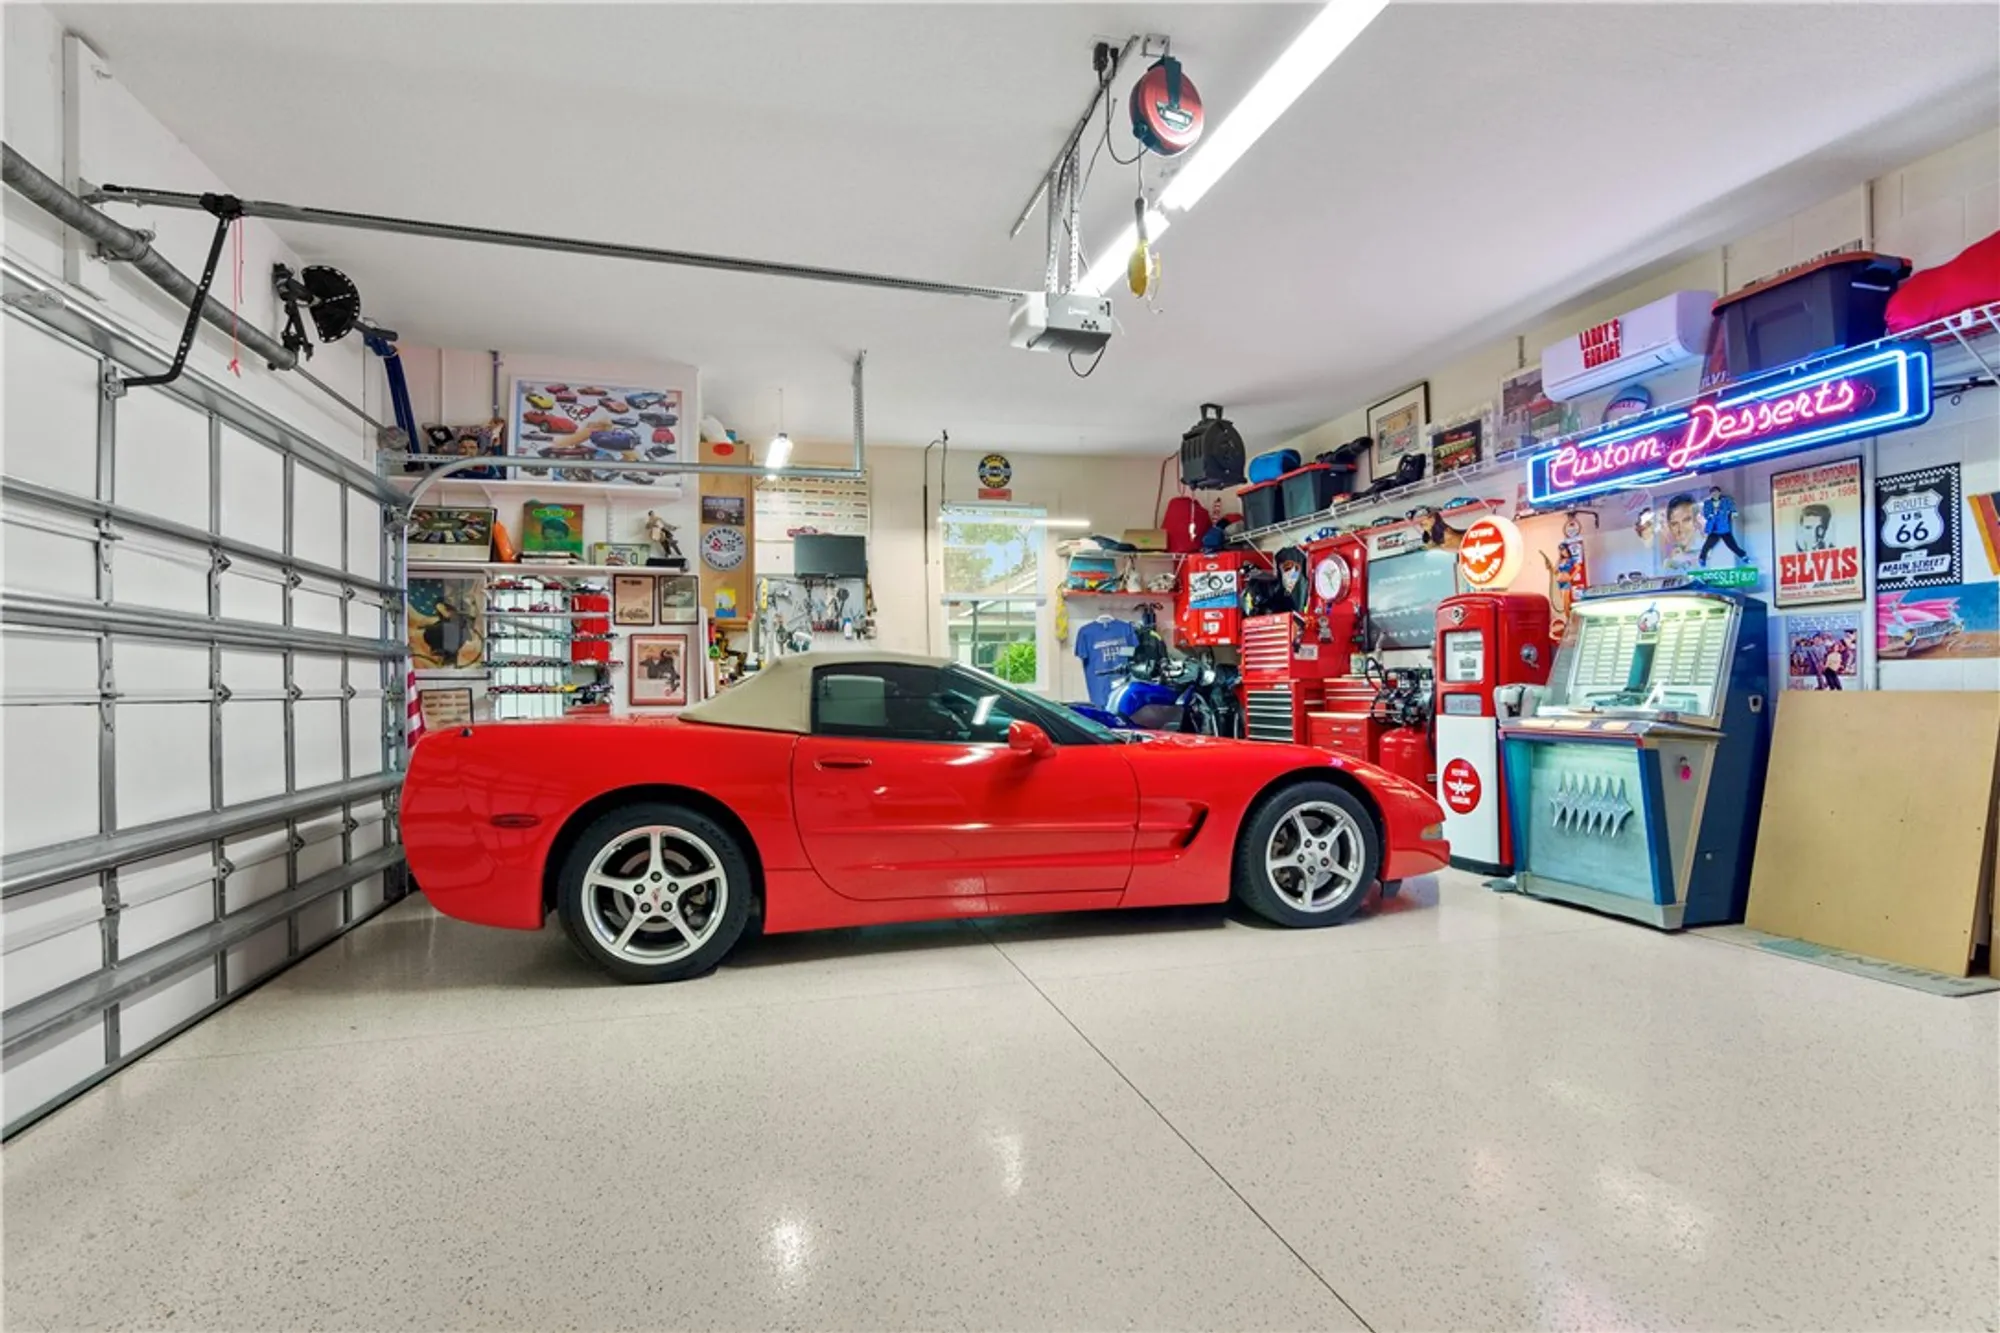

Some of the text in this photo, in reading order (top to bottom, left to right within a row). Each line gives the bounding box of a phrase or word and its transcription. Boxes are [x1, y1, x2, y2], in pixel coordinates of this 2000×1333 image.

[1578, 318, 1619, 351] LARRY'S
[1584, 340, 1620, 369] GARAGE
[1551, 381, 1855, 487] Custom Desserts
[1893, 496, 1930, 510] ROUTE
[1901, 511, 1922, 521] US
[1896, 521, 1929, 543] 66
[1780, 547, 1858, 585] ELVIS
[1882, 557, 1946, 573] MAIN STREET
